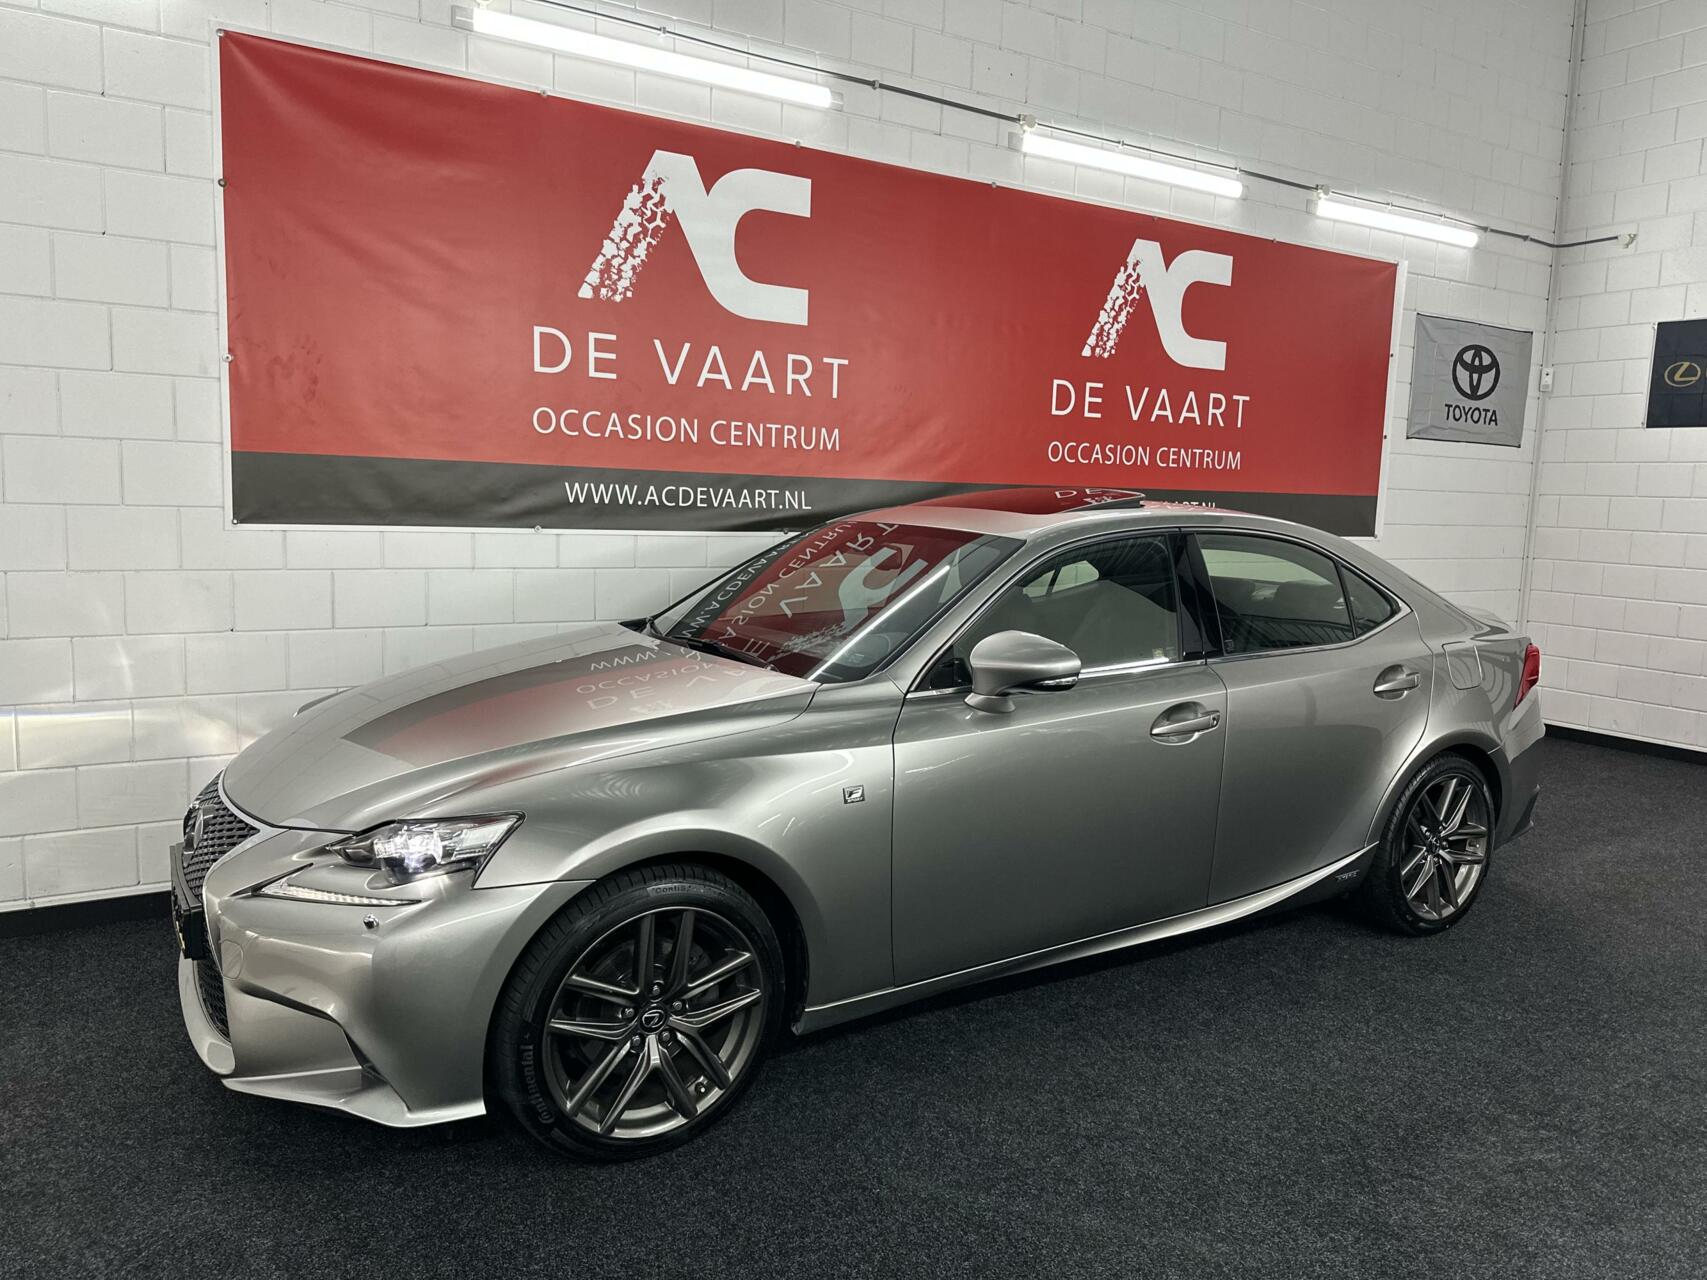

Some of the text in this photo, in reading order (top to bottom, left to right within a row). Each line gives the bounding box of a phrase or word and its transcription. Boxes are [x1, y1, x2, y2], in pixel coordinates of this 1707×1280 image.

[577, 149, 811, 326] AC
[1081, 238, 1234, 371] AC
[533, 325, 849, 399] DE VAART
[1050, 378, 1250, 428] DE VAART
[1444, 403, 1498, 426] TOYOTA
[532, 406, 840, 451] OCCASION CENTRUM
[1048, 440, 1241, 471] OCCASION CENTRUM
[565, 482, 812, 510] WWW.ACDEVAART.NL
[520, 1045, 555, 1124] Continental
